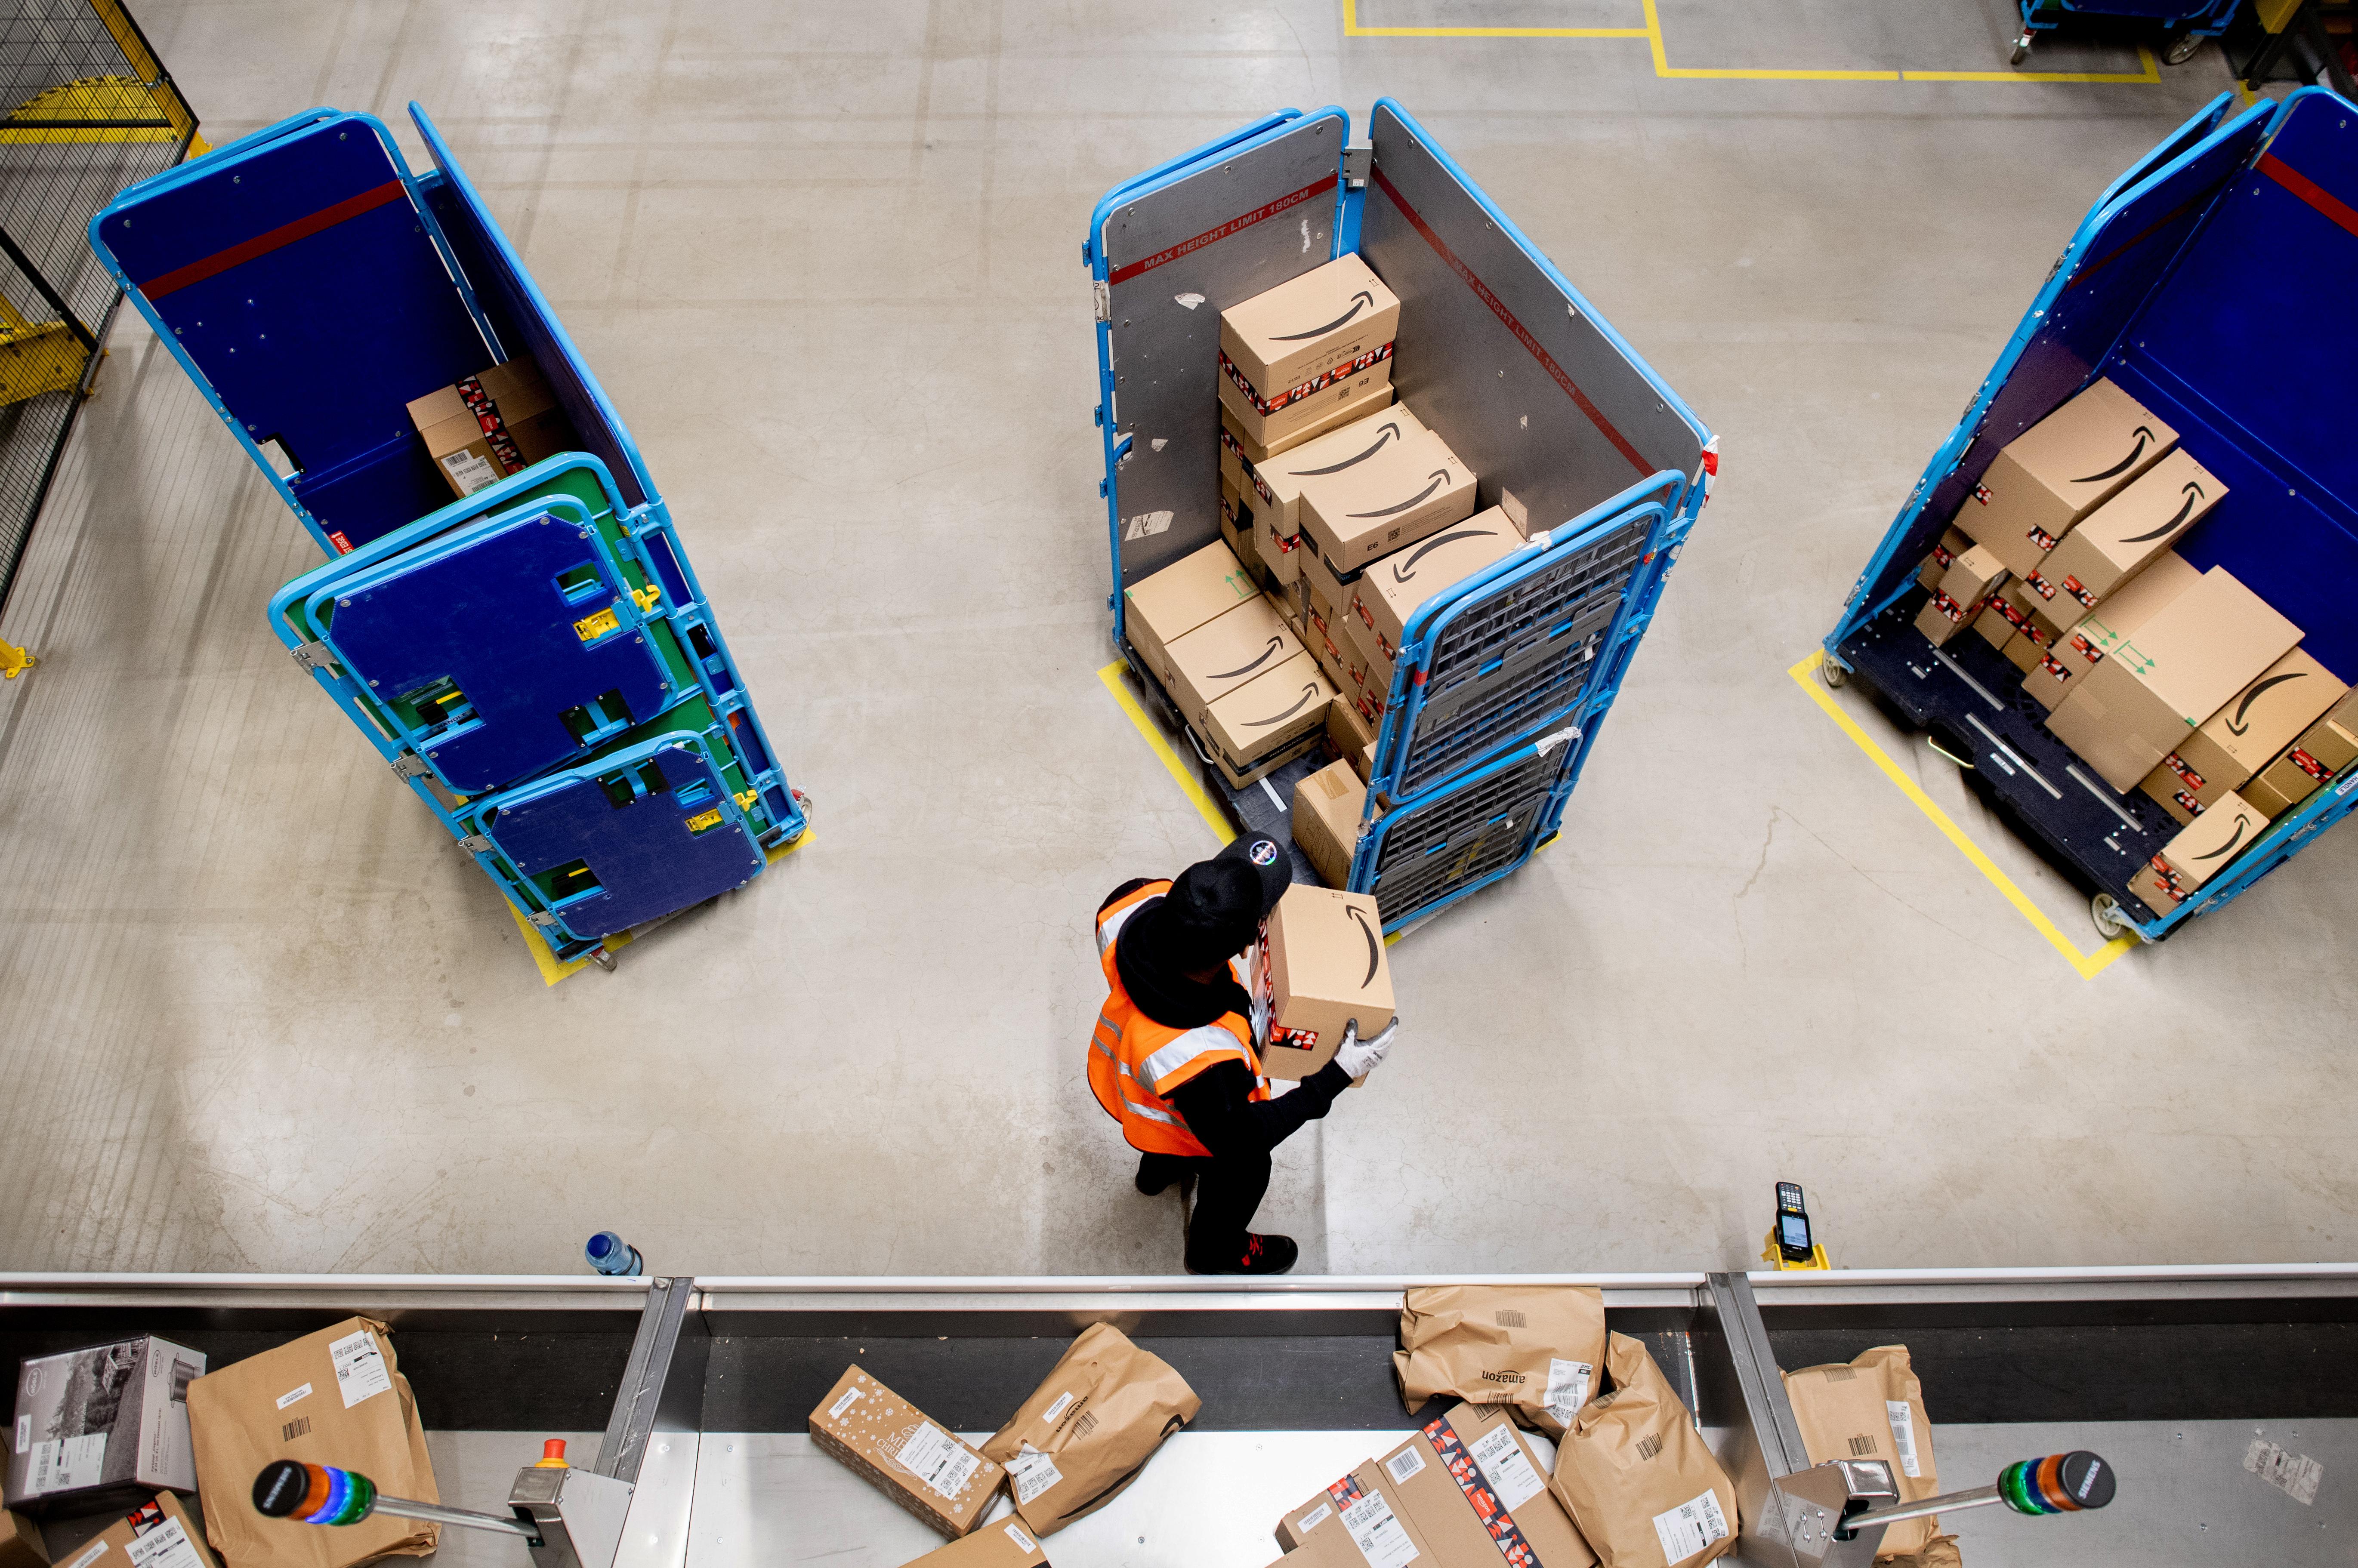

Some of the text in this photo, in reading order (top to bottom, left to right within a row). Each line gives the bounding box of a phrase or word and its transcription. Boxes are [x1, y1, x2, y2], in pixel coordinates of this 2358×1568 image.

[1144, 189, 1310, 268] MAX HEIGHT LIMIT 180CM
[1477, 286, 1514, 324] HEIGHT
[1515, 327, 1542, 355] LIMIT
[1543, 359, 1577, 394] 180CM
[1358, 378, 1369, 387] E6
[336, 535, 347, 548] EDGE
[1367, 542, 1378, 551] E6
[437, 713, 468, 728] HANDLE
[2338, 776, 2358, 793] HANDLE
[1482, 1371, 1525, 1384] amazon
[1056, 1396, 1089, 1432] amazon
[877, 1439, 899, 1456] CHRI
[2078, 1461, 2100, 1498] SIEMENS
[1477, 1493, 1490, 1512] amazon
